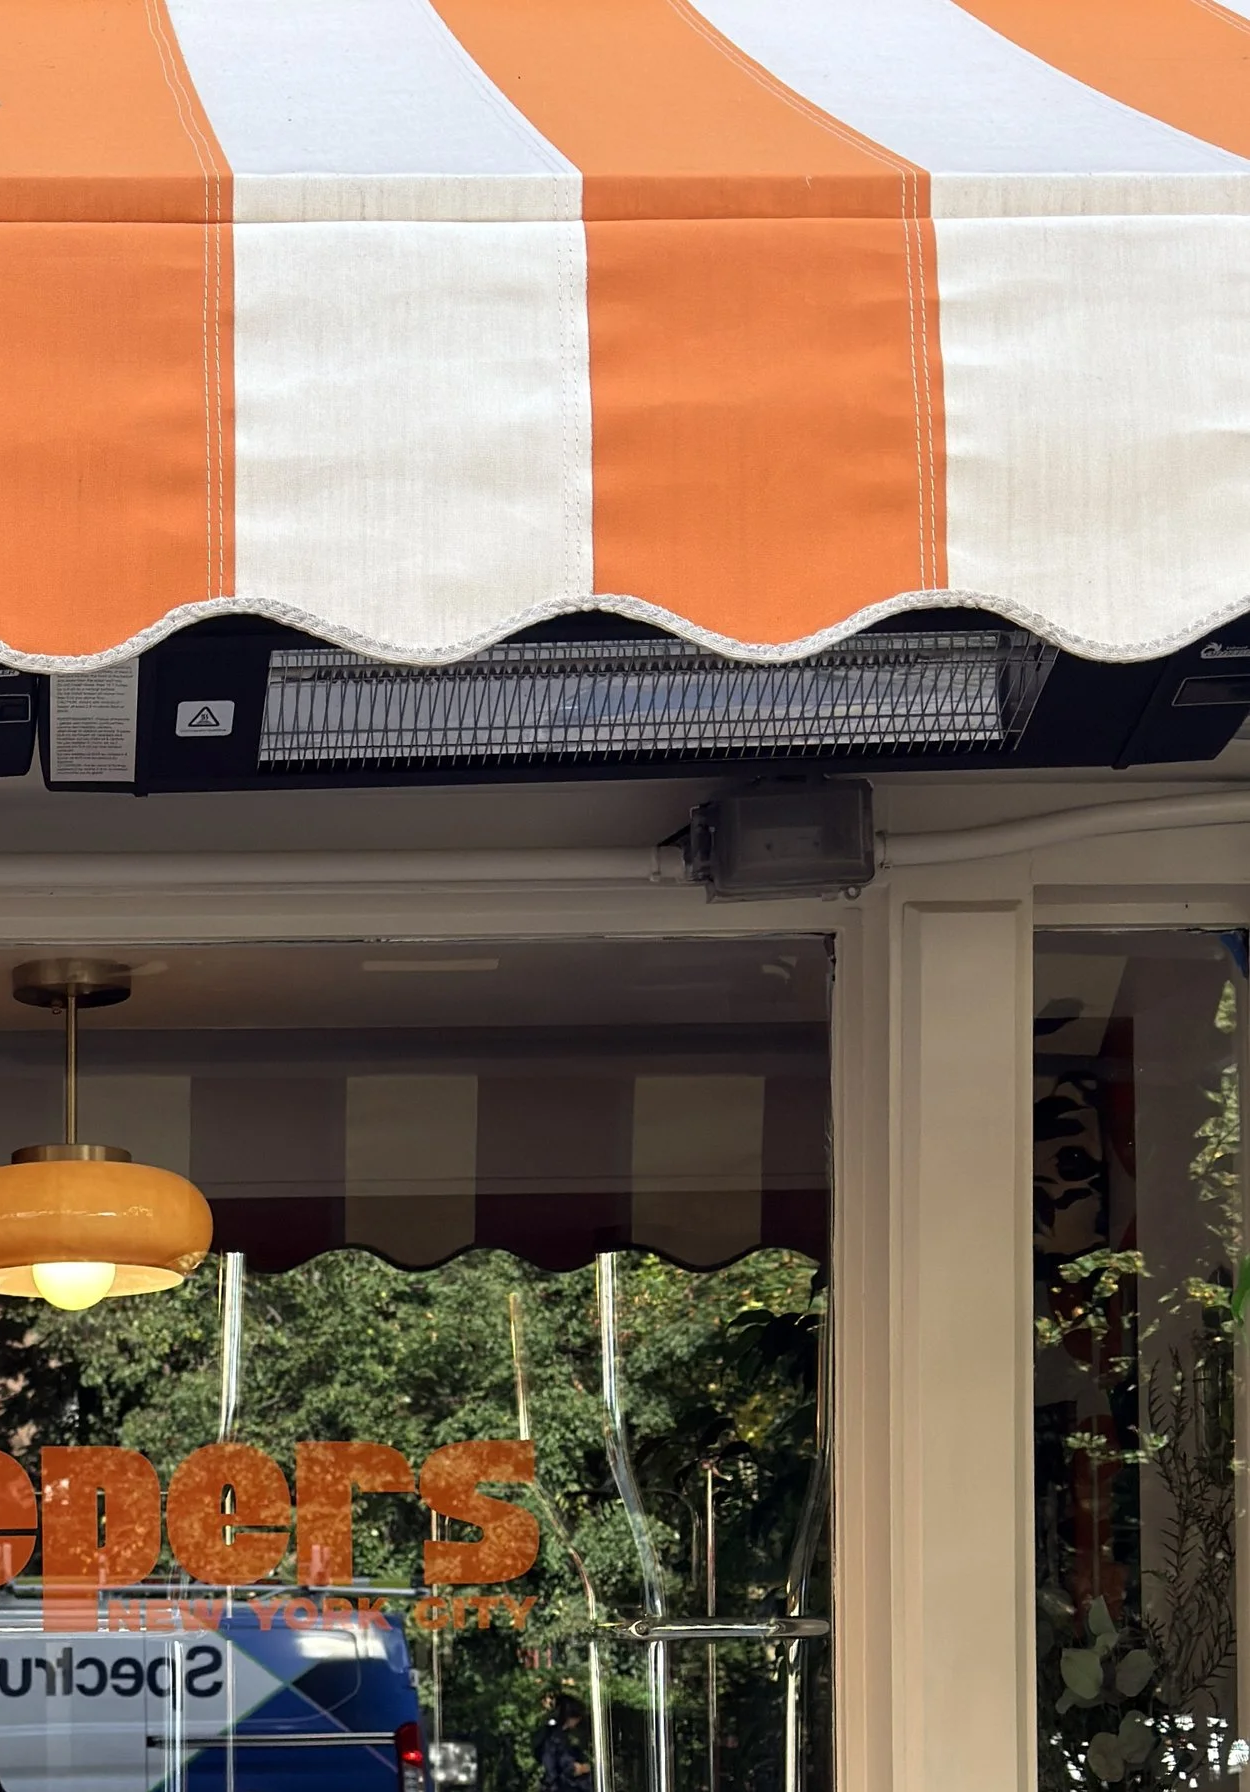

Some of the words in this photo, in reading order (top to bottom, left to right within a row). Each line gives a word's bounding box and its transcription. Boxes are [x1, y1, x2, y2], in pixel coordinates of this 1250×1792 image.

[107, 1598, 225, 1632] NEW
[250, 1597, 392, 1632] YORK
[414, 1595, 538, 1631] CITY
